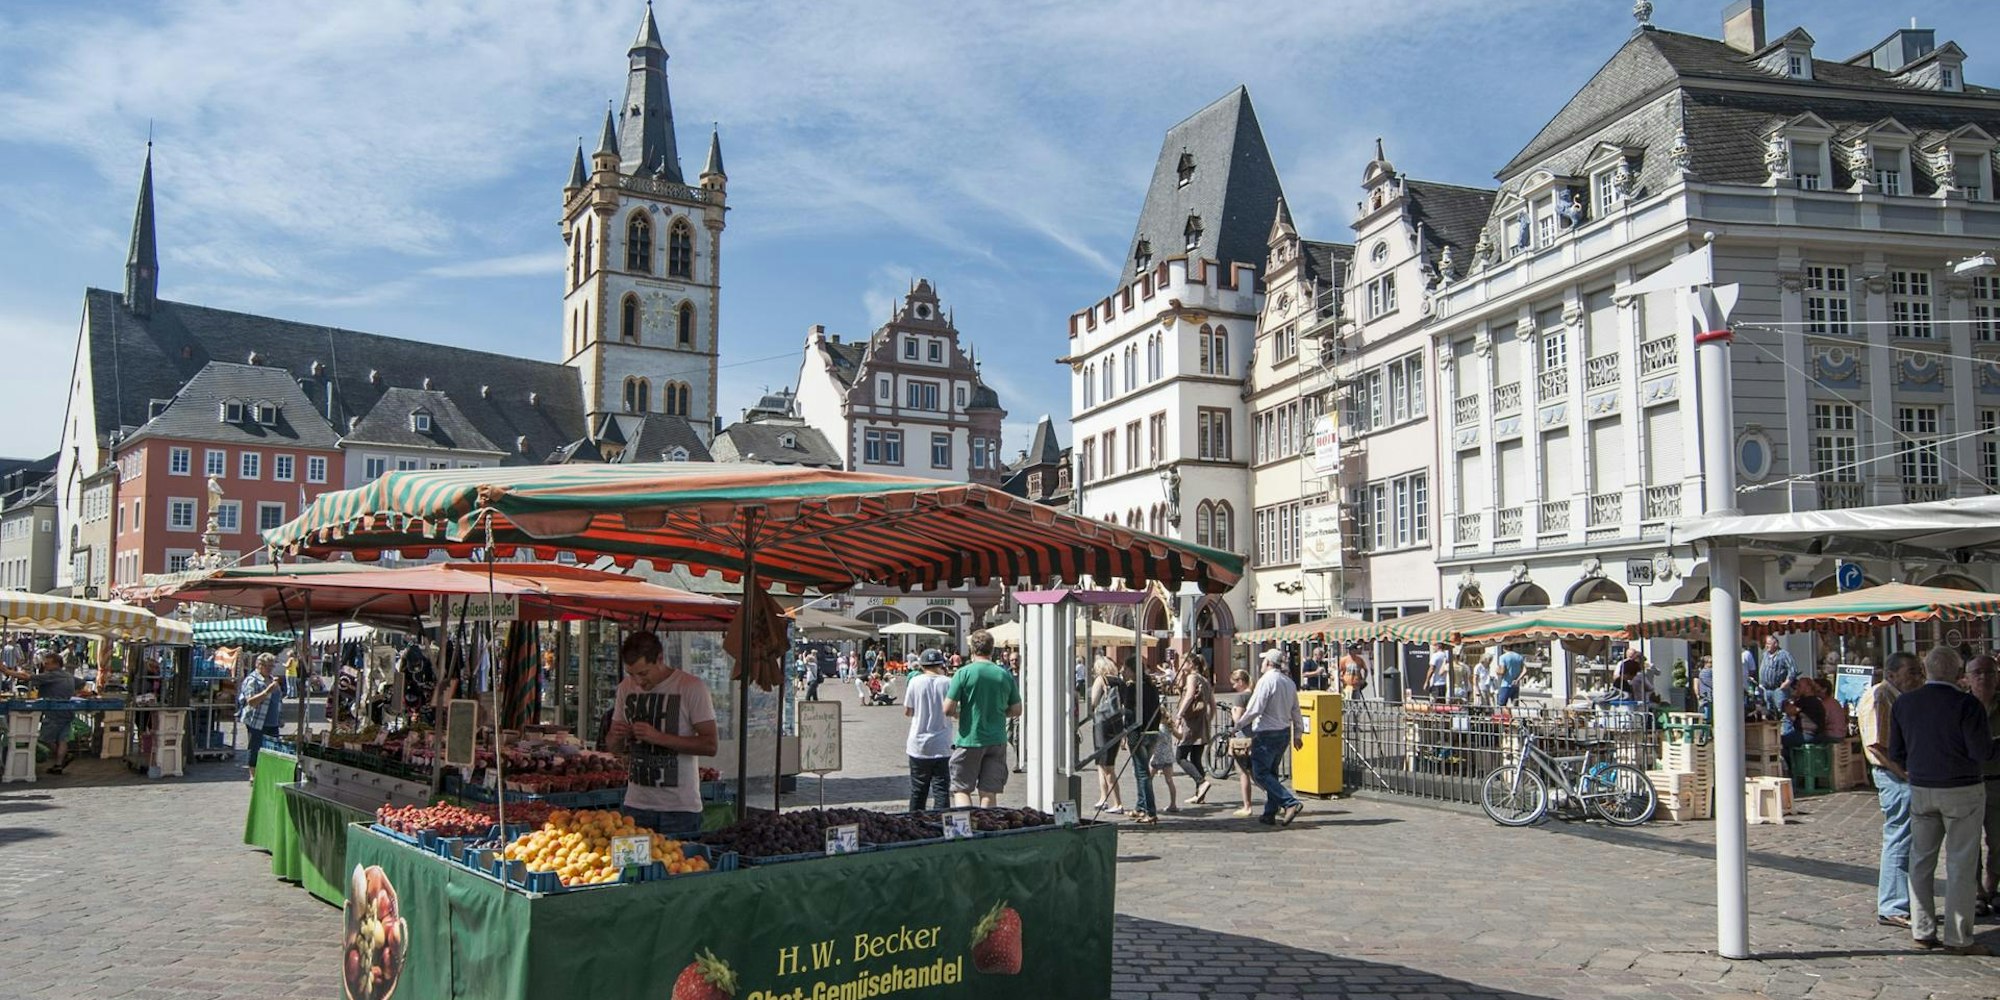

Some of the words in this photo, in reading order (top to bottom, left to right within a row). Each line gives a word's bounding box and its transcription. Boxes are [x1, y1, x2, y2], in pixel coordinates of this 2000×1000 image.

[432, 600, 515, 617] O-Geüsehndel
[926, 598, 955, 606] LAMBERT
[777, 939, 841, 976] H.W.
[853, 925, 941, 962] Becker
